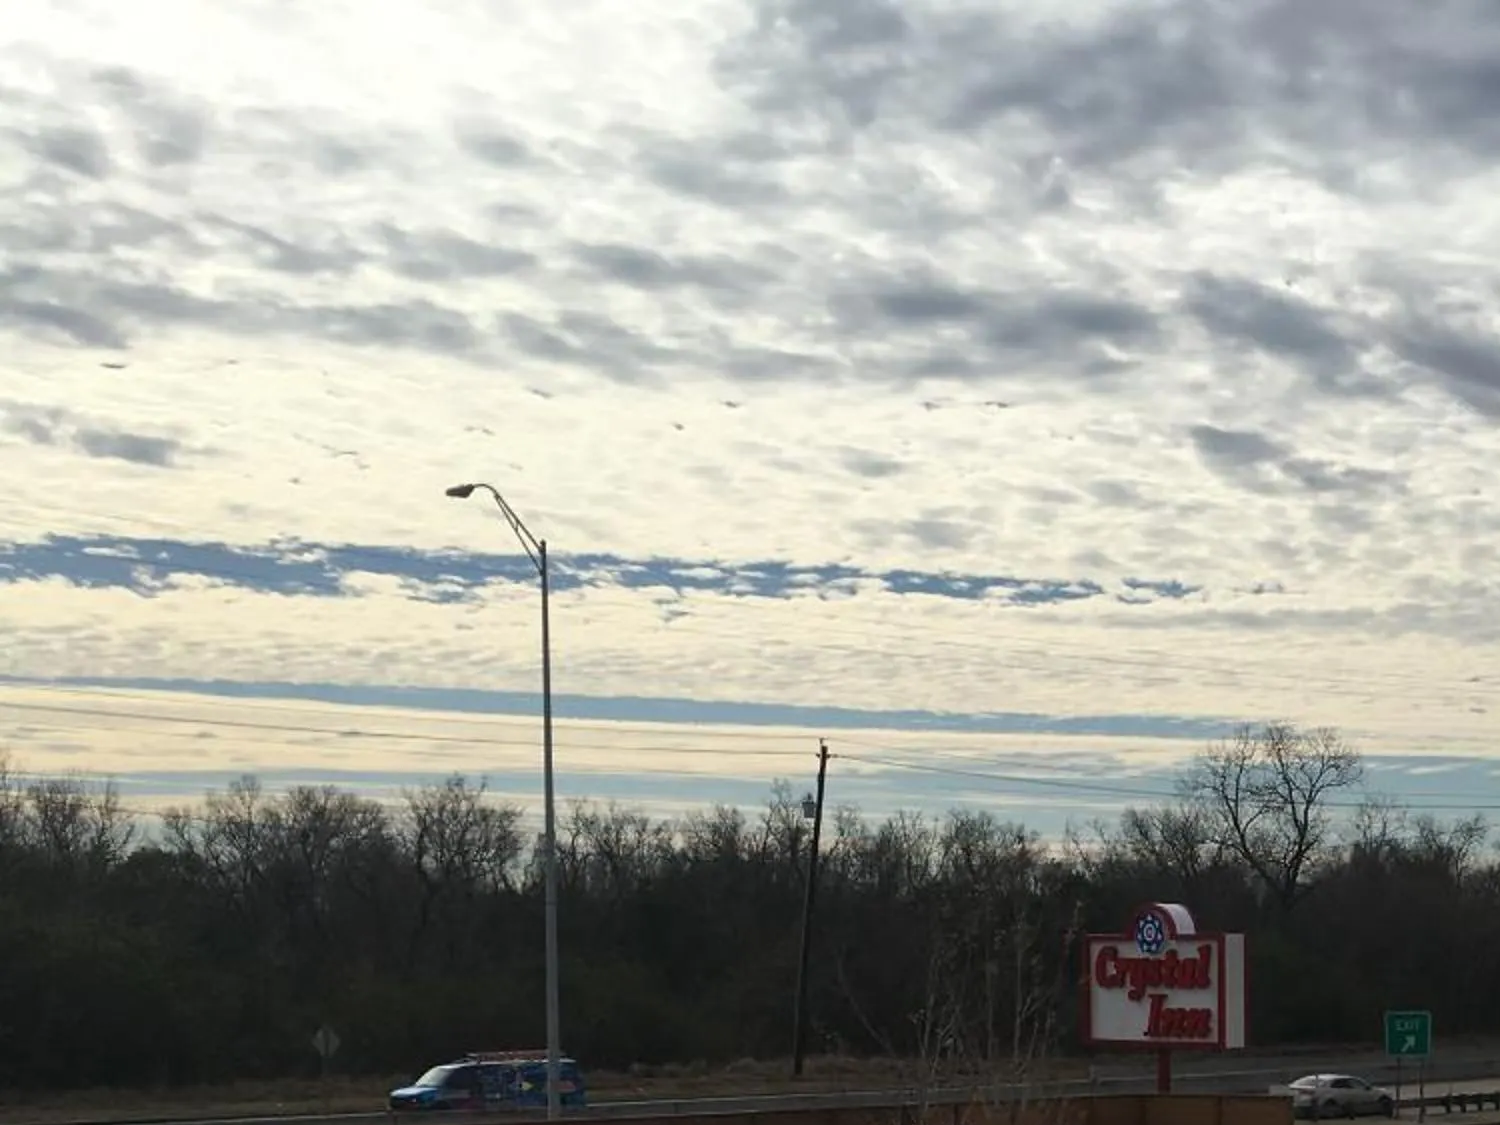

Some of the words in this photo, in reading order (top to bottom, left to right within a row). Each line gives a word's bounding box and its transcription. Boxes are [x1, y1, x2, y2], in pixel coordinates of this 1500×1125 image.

[1096, 944, 1212, 1001] Crystal
[1147, 993, 1213, 1038] Inn
[1394, 1018, 1420, 1031] EXIT
